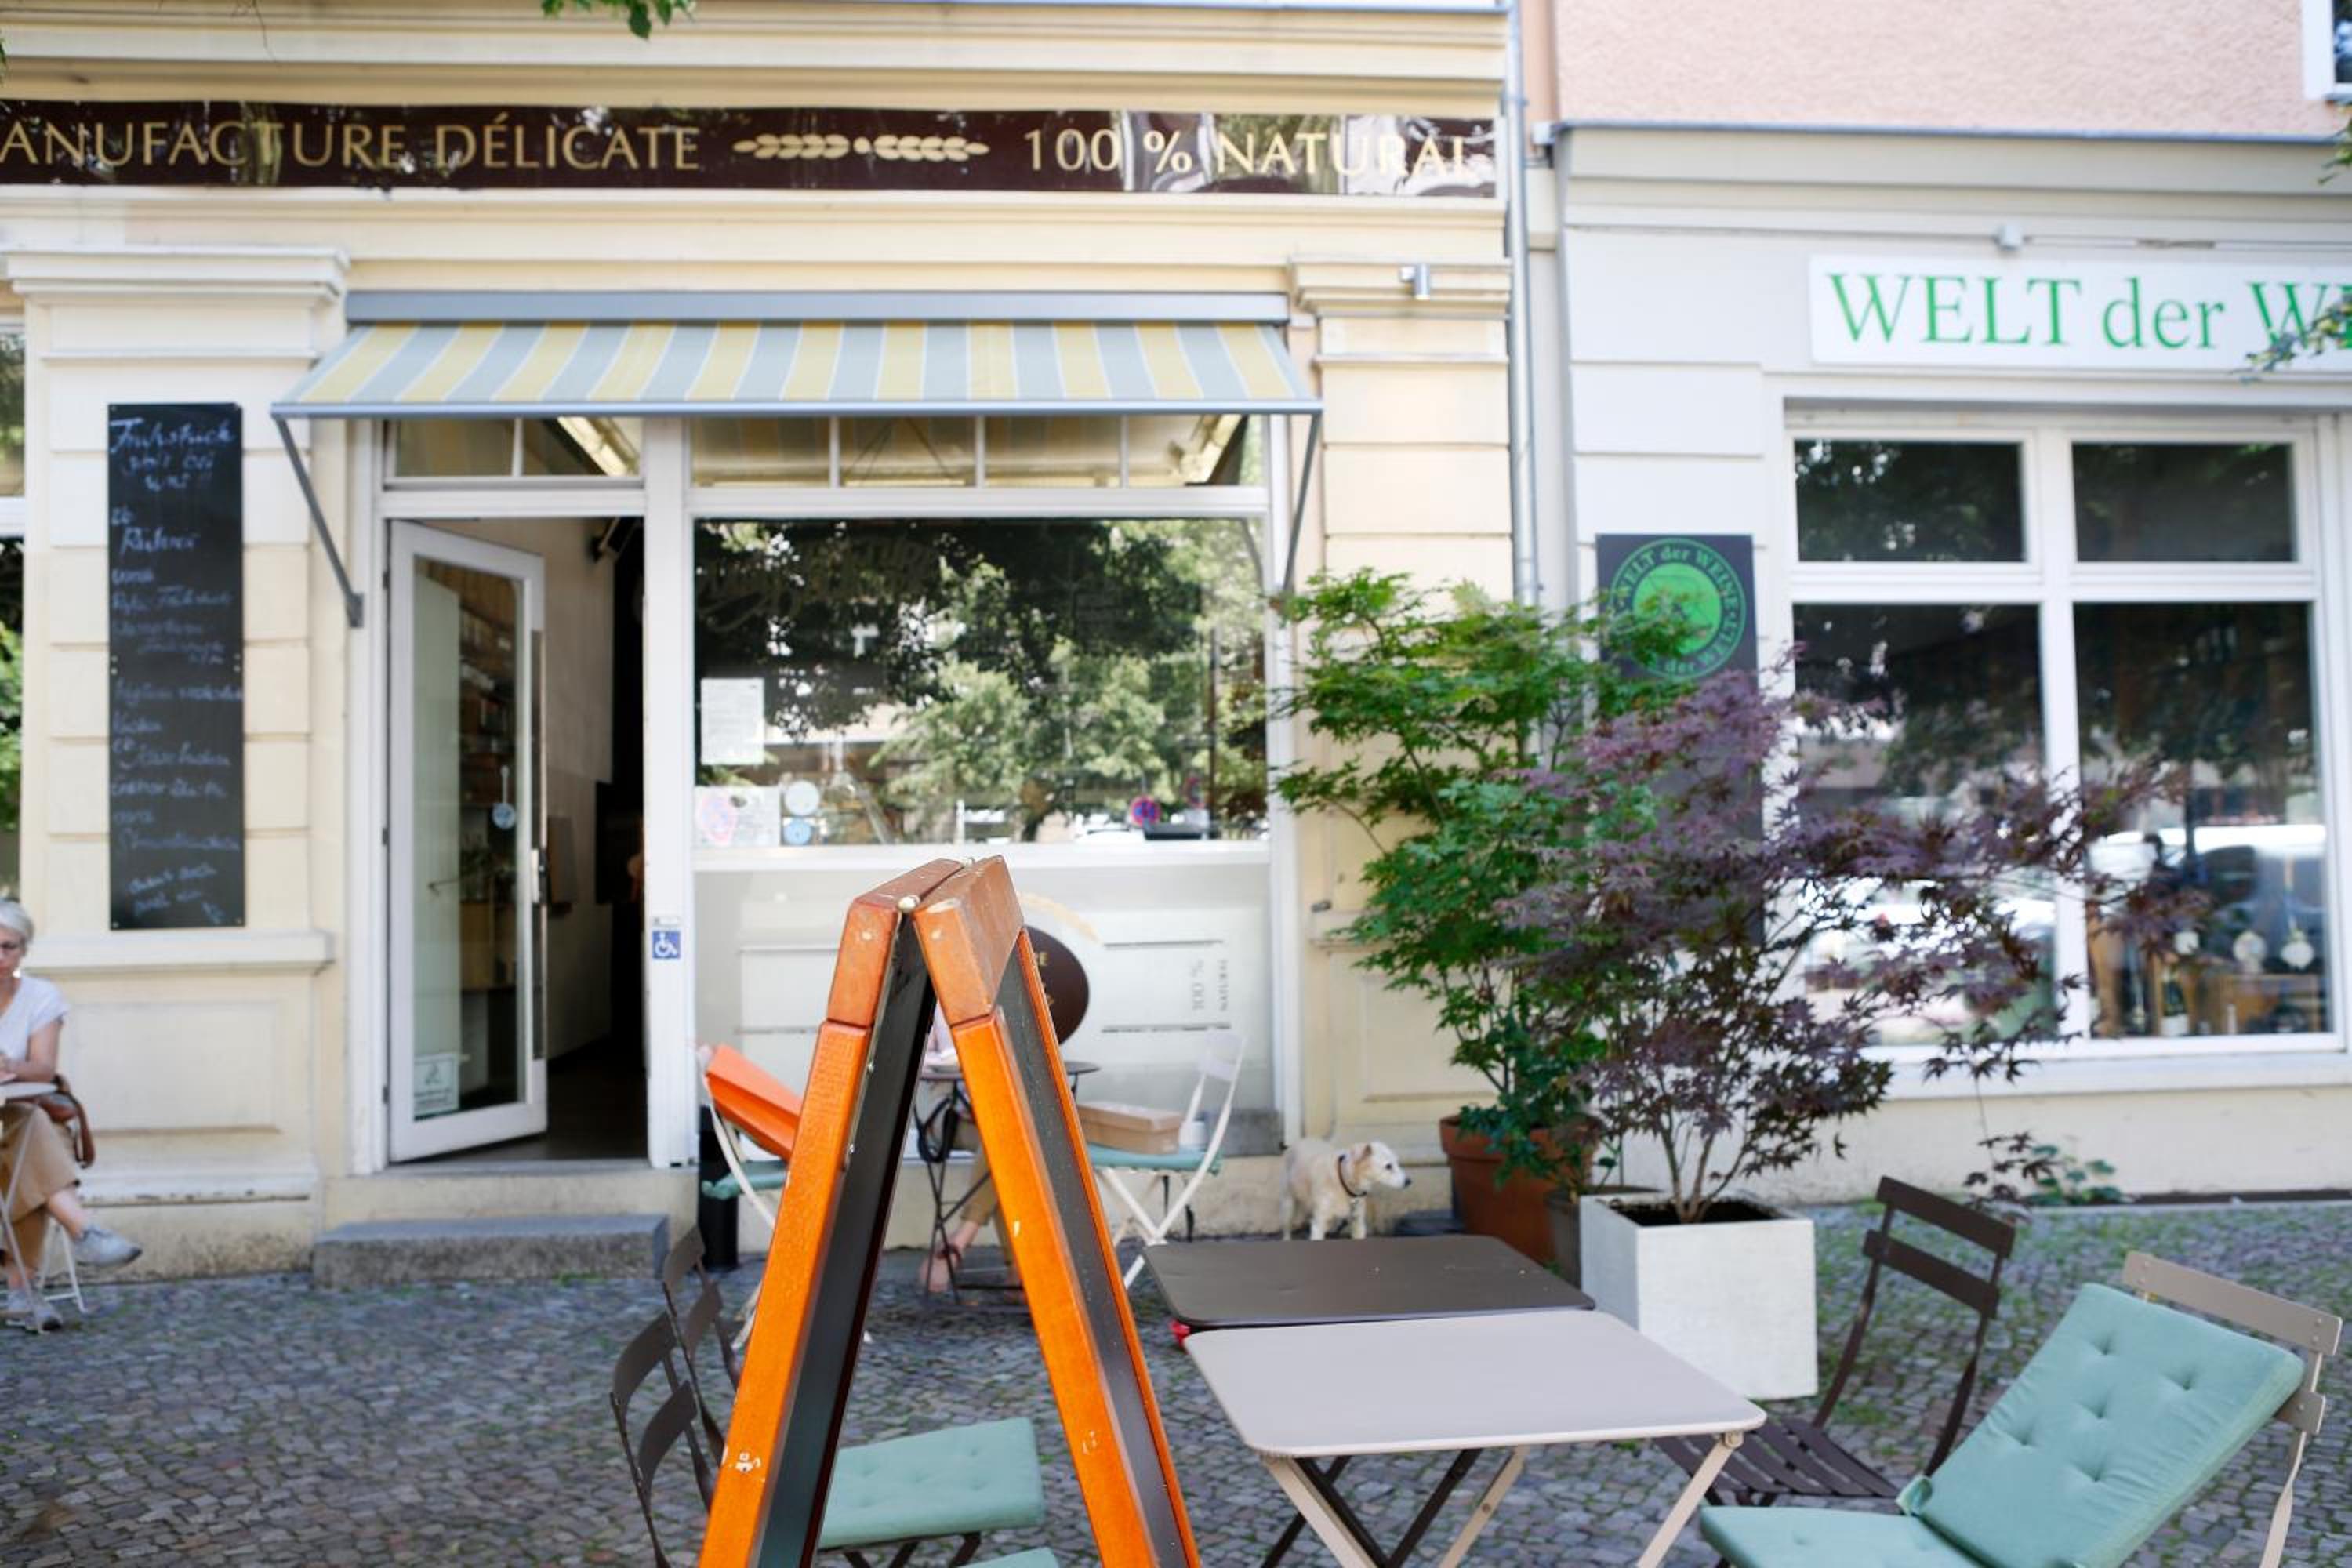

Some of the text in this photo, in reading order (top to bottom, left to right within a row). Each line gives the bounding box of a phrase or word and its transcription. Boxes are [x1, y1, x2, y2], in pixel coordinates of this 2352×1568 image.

[0, 114, 1477, 178] ANUFACTURE DÉLICATE 100 % NATURAL
[1826, 273, 2082, 346] WELT
[2101, 276, 2225, 350] der
[1660, 544, 1690, 561] der
